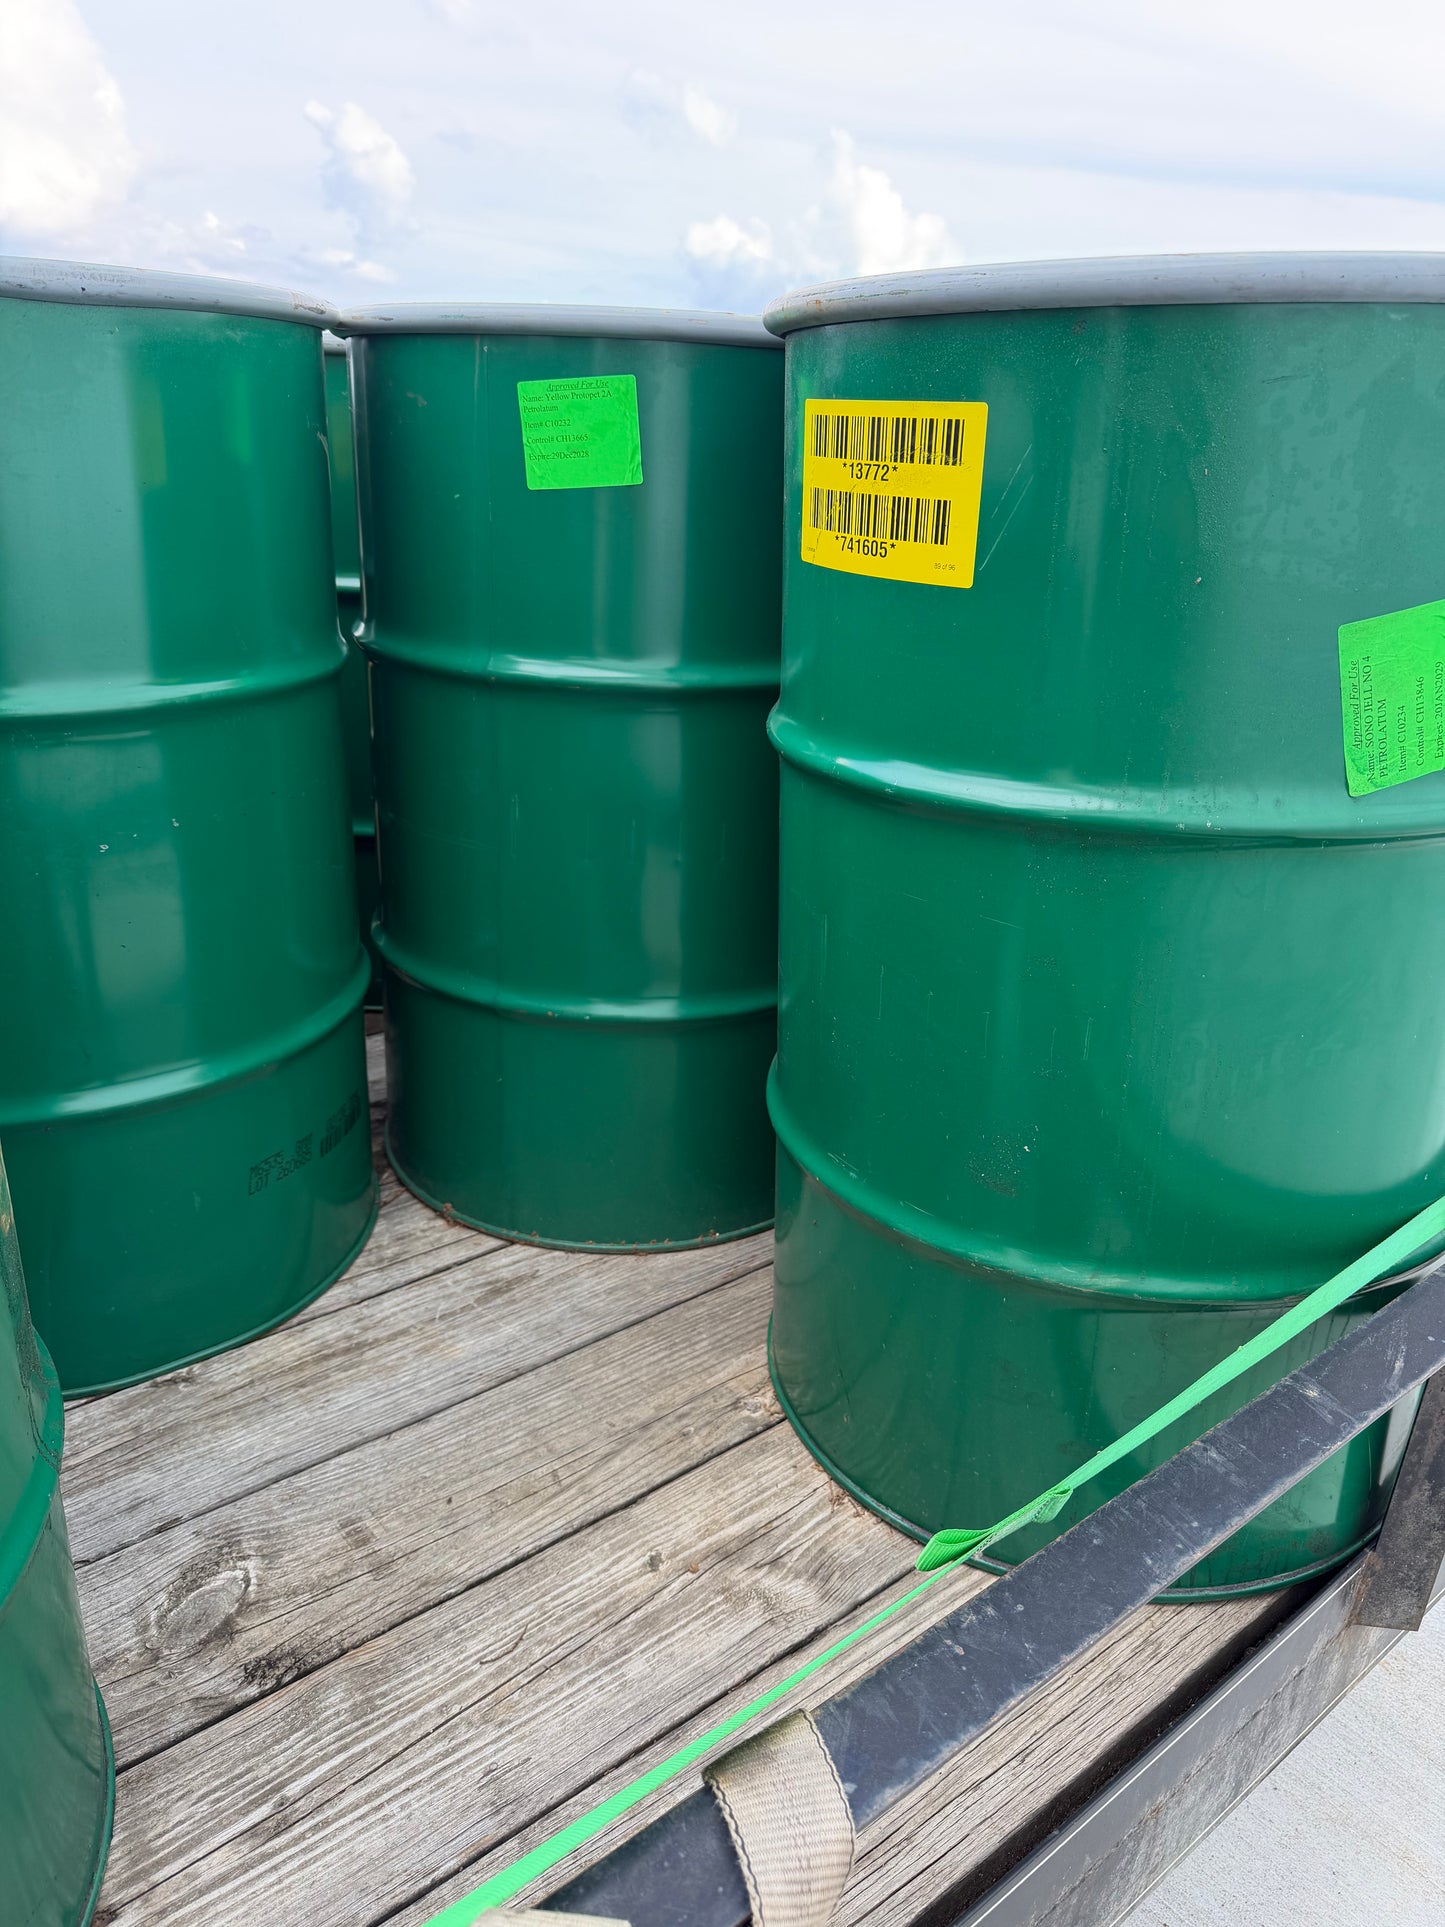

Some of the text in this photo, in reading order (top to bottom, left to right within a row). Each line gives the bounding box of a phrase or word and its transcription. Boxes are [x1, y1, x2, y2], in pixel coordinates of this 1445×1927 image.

[522, 389, 612, 403] Name: Yellow Protopet 2A
[523, 404, 559, 414] Petrolatum
[547, 379, 609, 392] Approved For Use
[1348, 660, 1363, 750] Approved For Use
[1362, 655, 1375, 782] Name: SONO JELL NO 4
[1377, 698, 1388, 778] PETROLATUM
[1397, 705, 1407, 773] Item# C10234
[1415, 676, 1425, 767] Control# CH13846
[1434, 661, 1445, 759] Expires: 20JAN2029
